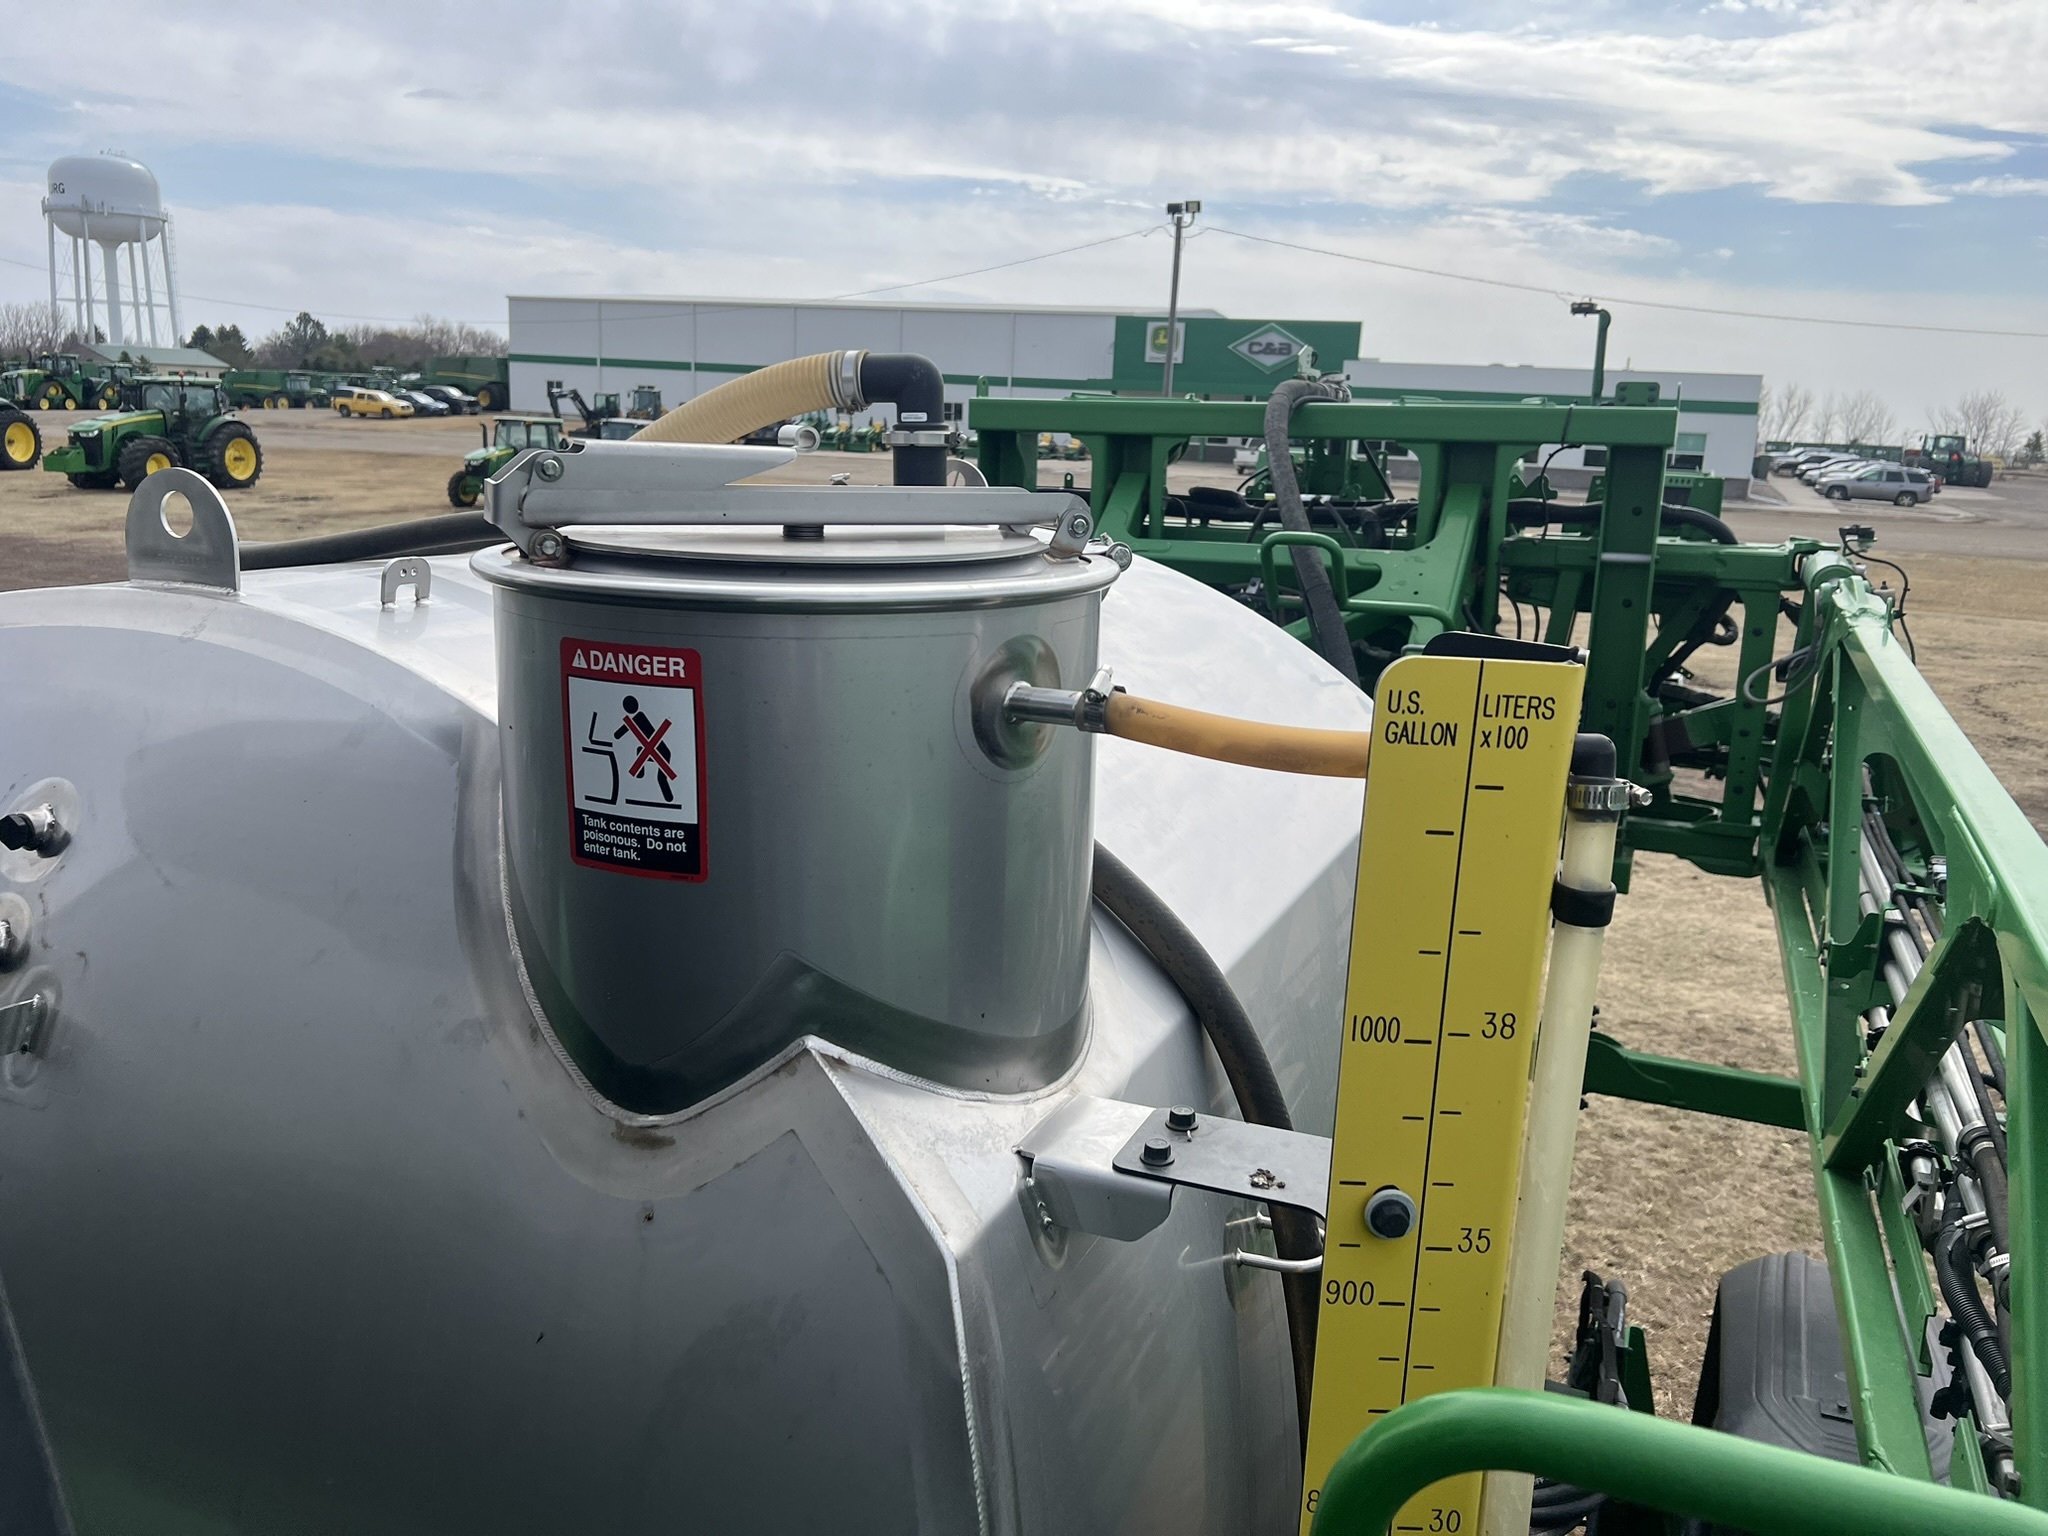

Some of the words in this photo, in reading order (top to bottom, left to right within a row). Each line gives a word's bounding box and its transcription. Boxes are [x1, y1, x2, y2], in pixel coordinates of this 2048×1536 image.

[1248, 341, 1292, 356] C&B
[589, 650, 685, 678] DANGER
[1387, 689, 1424, 715] U.S.
[1482, 693, 1556, 720] LITERS
[1384, 720, 1458, 747] GALLON
[1479, 725, 1529, 750] x100
[582, 814, 607, 829] Tank
[609, 821, 661, 837] contents
[664, 828, 685, 839] are
[583, 829, 641, 848] poisonous.
[646, 837, 663, 851] Do
[666, 841, 687, 853] not
[583, 842, 610, 856] enter
[612, 846, 641, 861] tank.
[1351, 1014, 1401, 1044] 1000
[1481, 1011, 1517, 1040] 38
[1457, 1227, 1492, 1254] 35
[1325, 1279, 1376, 1306] 900
[1428, 1508, 1462, 1533] 30
